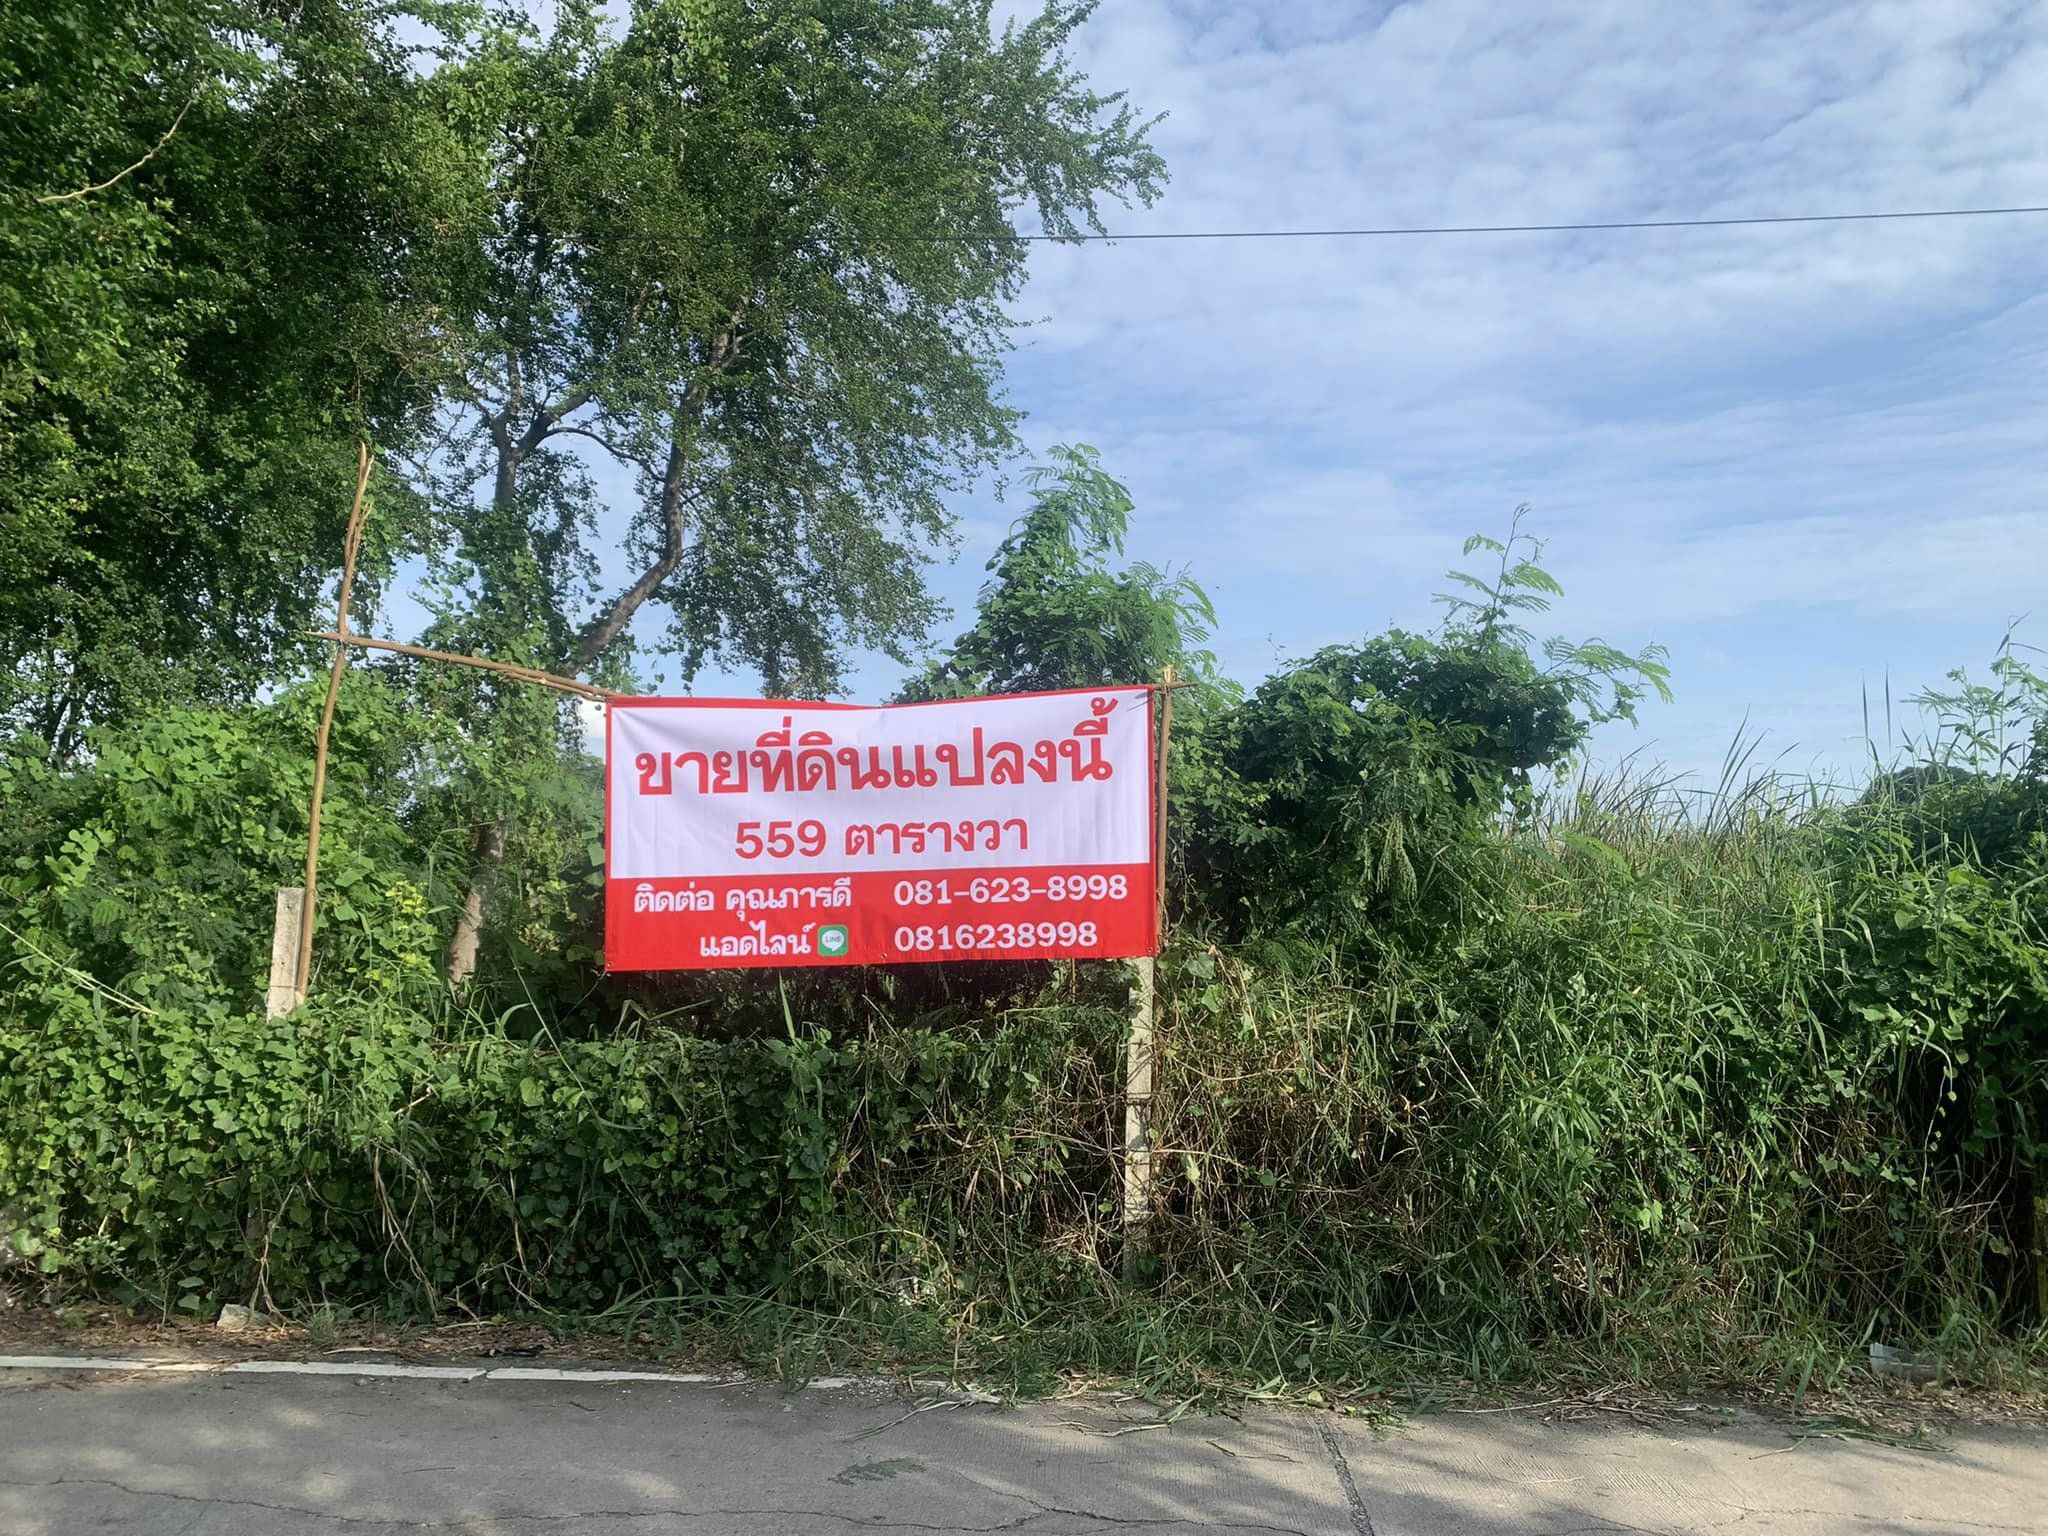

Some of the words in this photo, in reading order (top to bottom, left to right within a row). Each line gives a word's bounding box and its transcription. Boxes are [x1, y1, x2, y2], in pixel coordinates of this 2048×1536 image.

[635, 697, 1118, 795] ขายที่ดินแปลงนี้
[735, 819, 827, 860] 559
[845, 818, 1029, 856] ตารางวา
[634, 881, 715, 913] ติดต่อ
[894, 874, 1128, 907] 081-623-8998
[700, 920, 815, 958] แอดไลน์
[825, 935, 842, 943] LINE
[894, 921, 1098, 952] 0816238998
